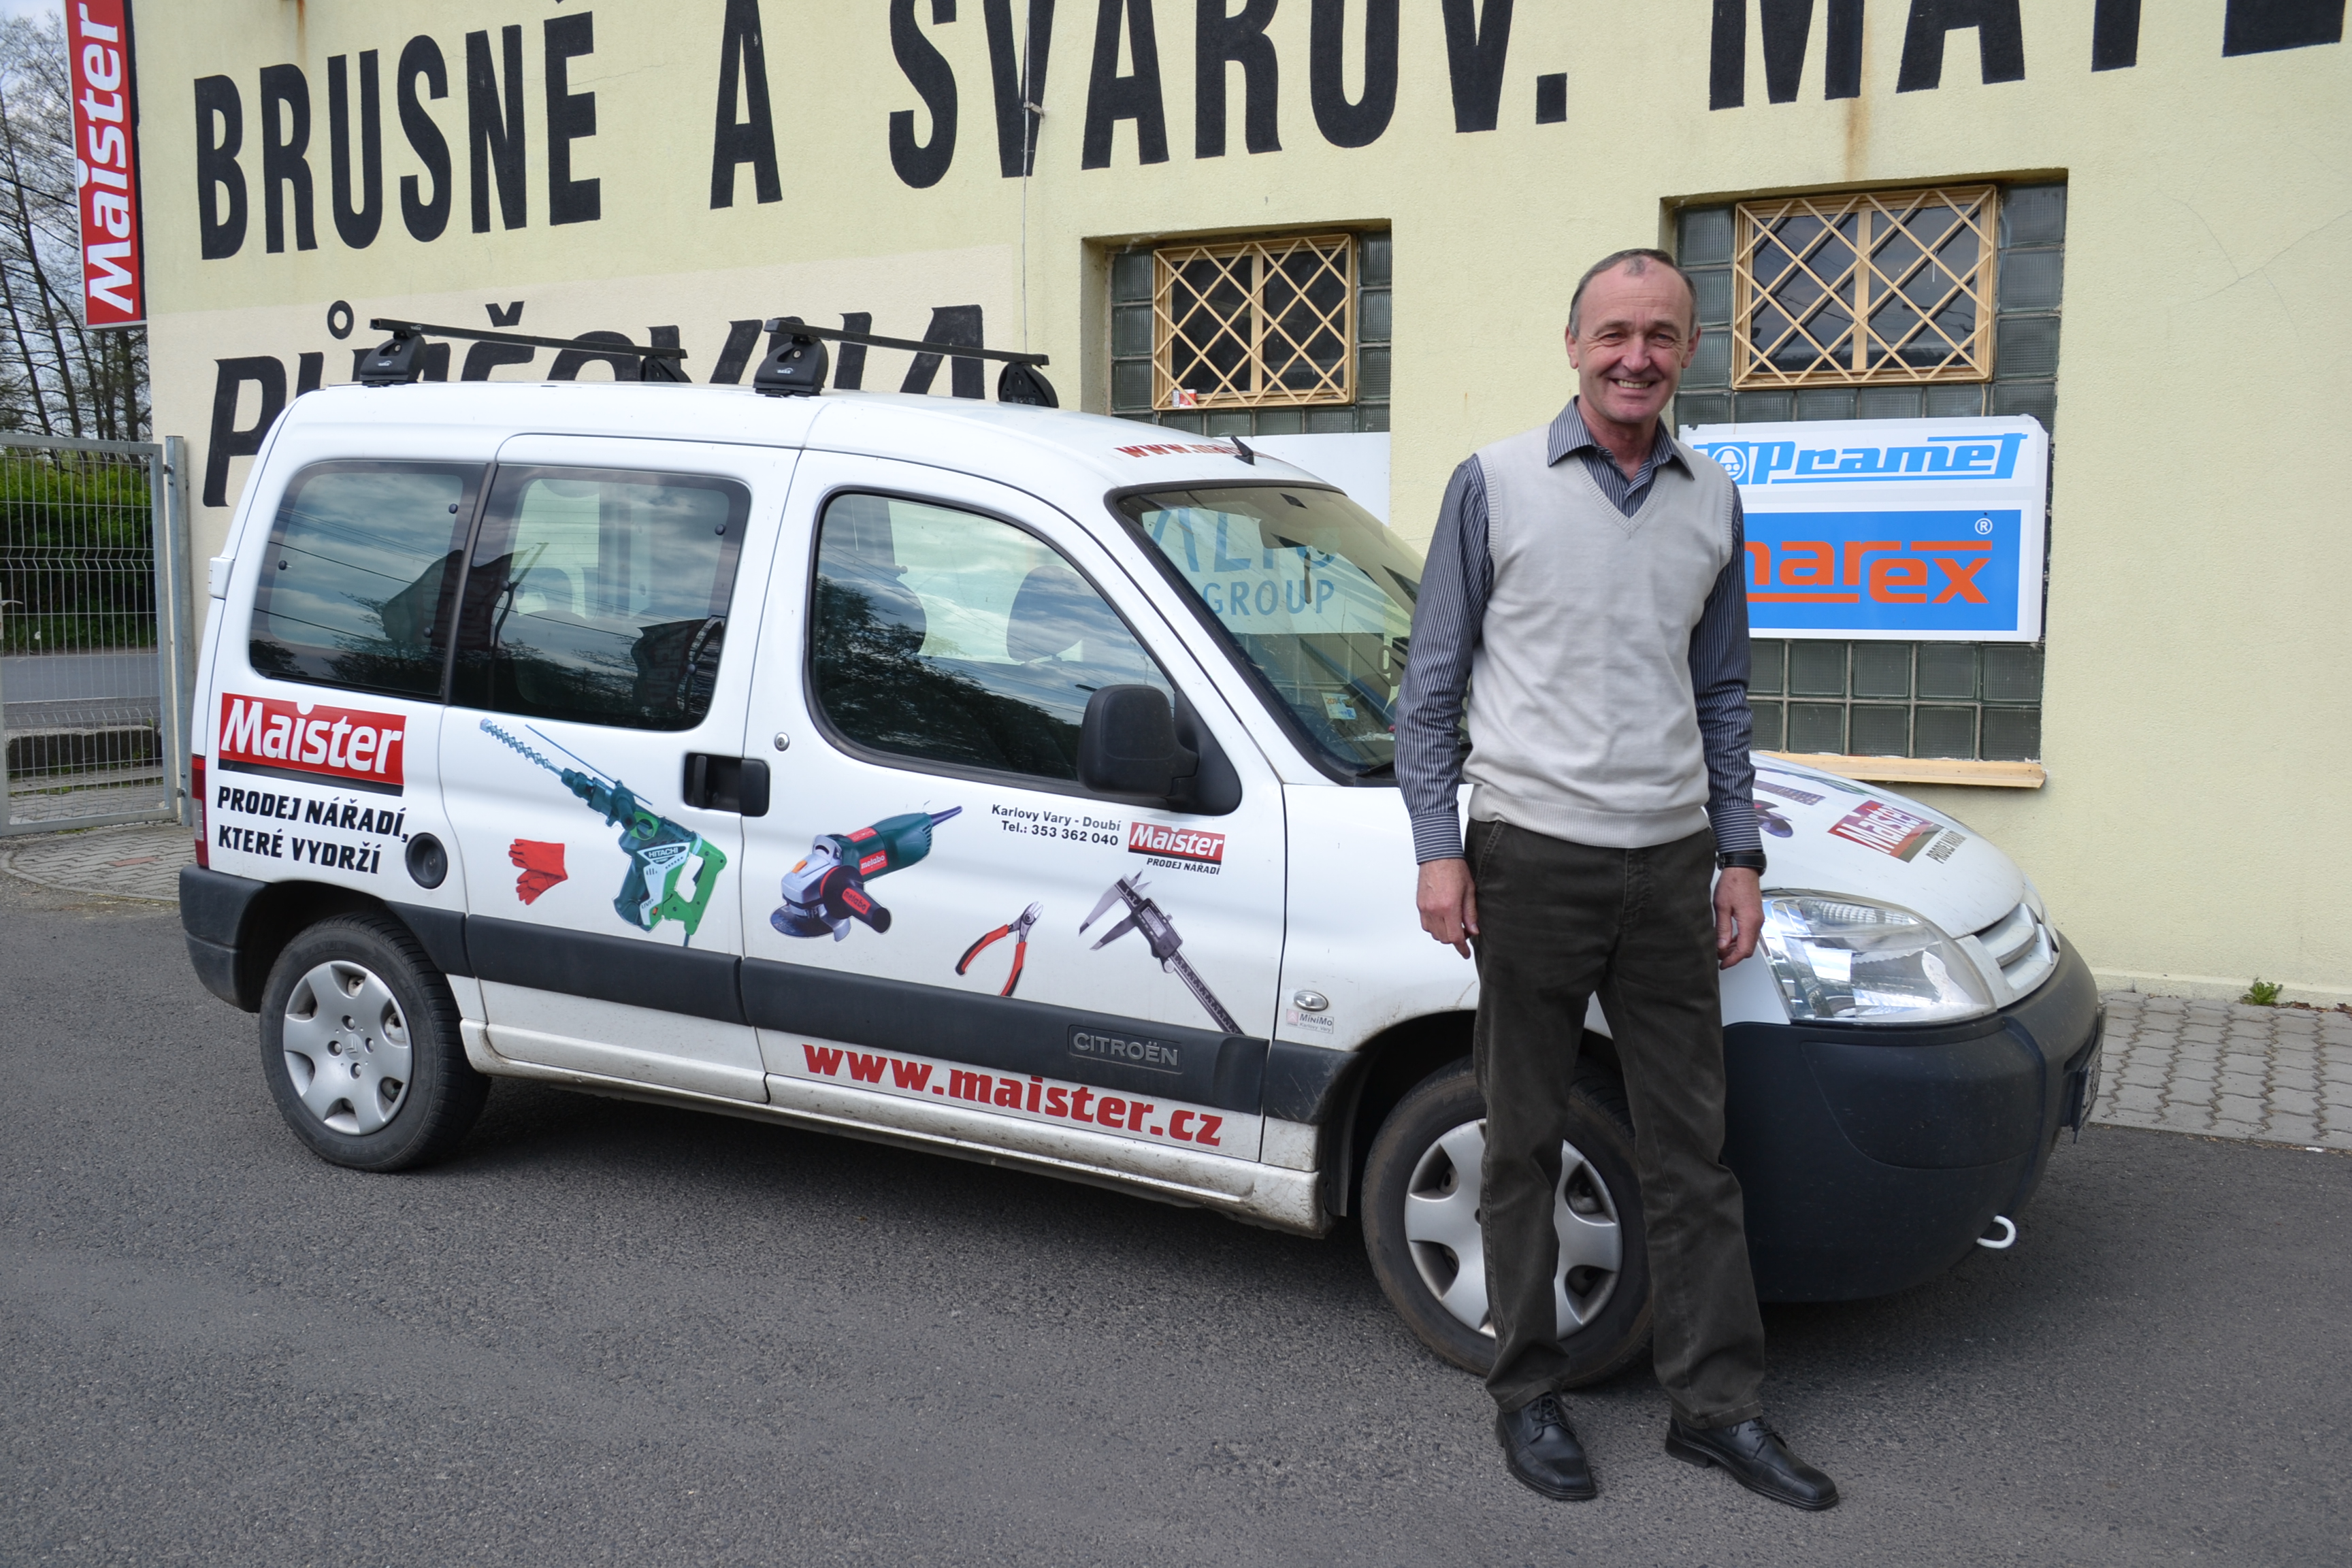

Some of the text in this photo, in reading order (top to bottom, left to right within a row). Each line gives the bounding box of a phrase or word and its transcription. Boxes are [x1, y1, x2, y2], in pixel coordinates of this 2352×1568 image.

[710, 0, 783, 210] A
[77, 3, 133, 314] Maister
[1751, 433, 2028, 485] Pramet
[1203, 578, 1335, 616] GROUP
[220, 698, 403, 774] Maister
[217, 786, 409, 843] PRODEJ NÁŘADÍ,
[992, 804, 1039, 822] Karlovy
[1043, 811, 1072, 826] Vary
[1083, 816, 1122, 832] Doubí
[1002, 820, 1119, 846] Tel.: 353 362 040
[1835, 804, 1923, 854] Maister
[218, 824, 381, 874] KTERÉ VYDRŽÍ
[649, 847, 679, 858] HITACHI
[1130, 824, 1224, 857] Maister
[1147, 858, 1222, 875] PRODEJ NÁŘADÍ
[1073, 1032, 1178, 1066] CITROËN
[802, 1043, 1223, 1147] www.maister.cz
